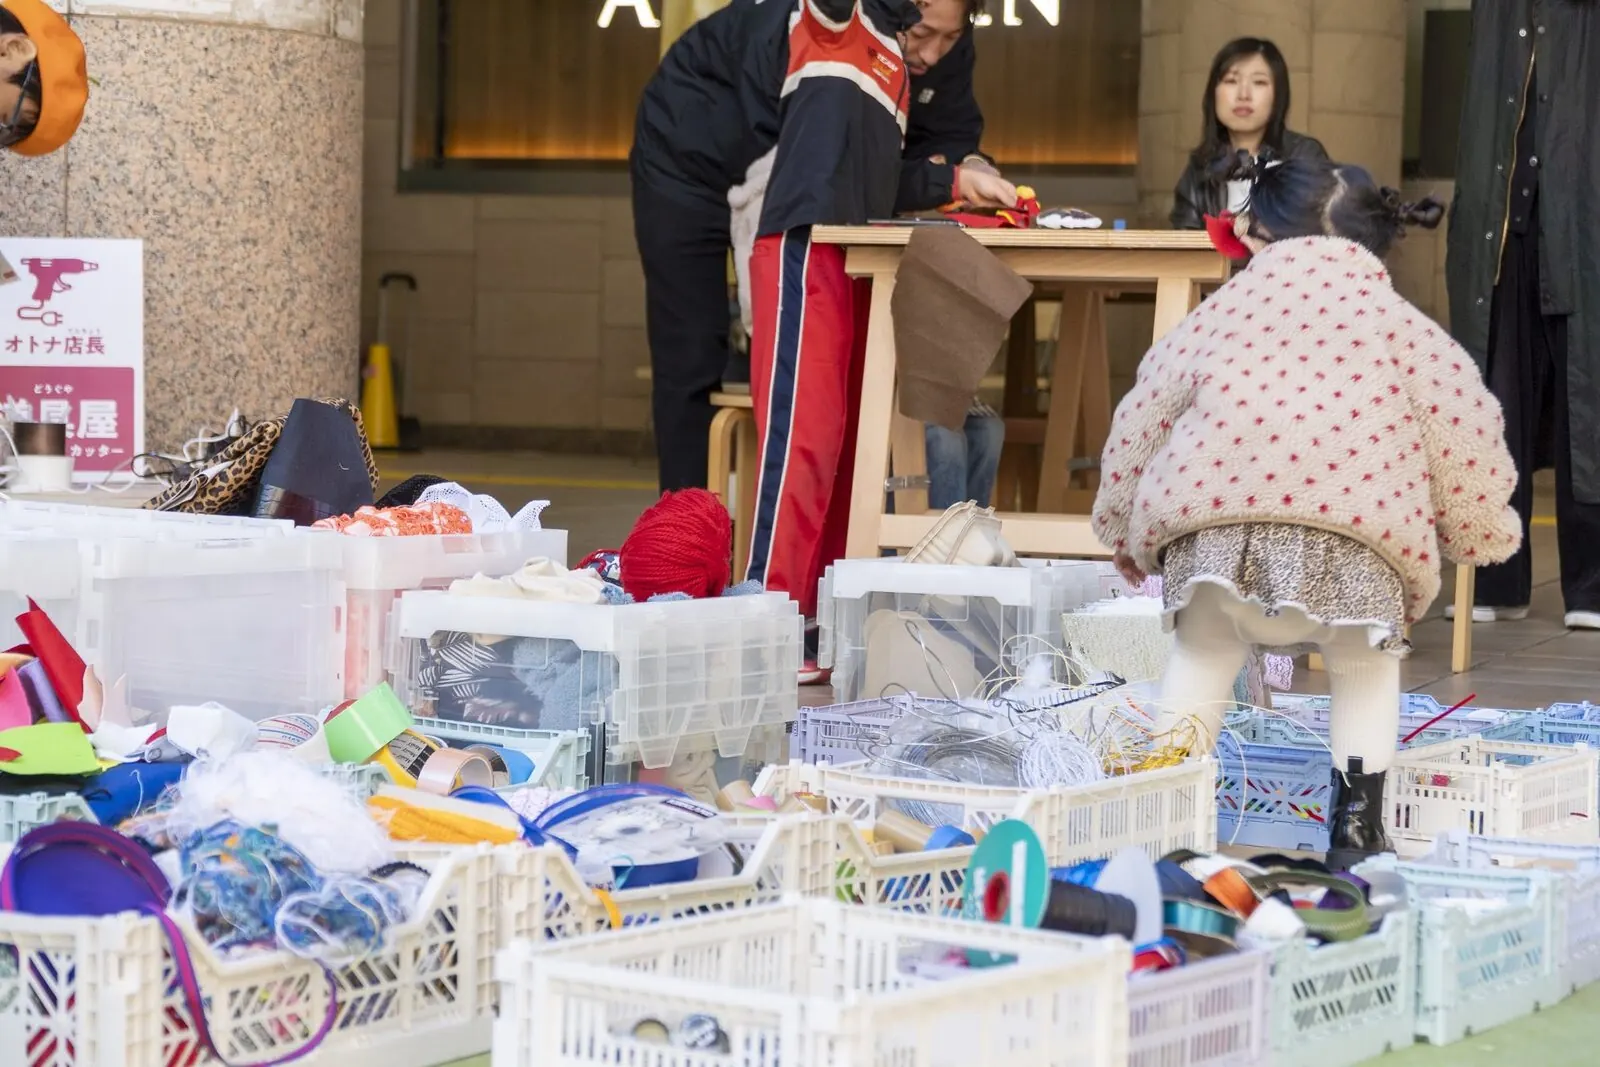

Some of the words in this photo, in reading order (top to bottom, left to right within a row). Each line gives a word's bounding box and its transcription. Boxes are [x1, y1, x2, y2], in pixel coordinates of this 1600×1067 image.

[5, 335, 106, 356] オトナ店長
[33, 383, 74, 395] どうぐや
[69, 443, 125, 458] カッター
